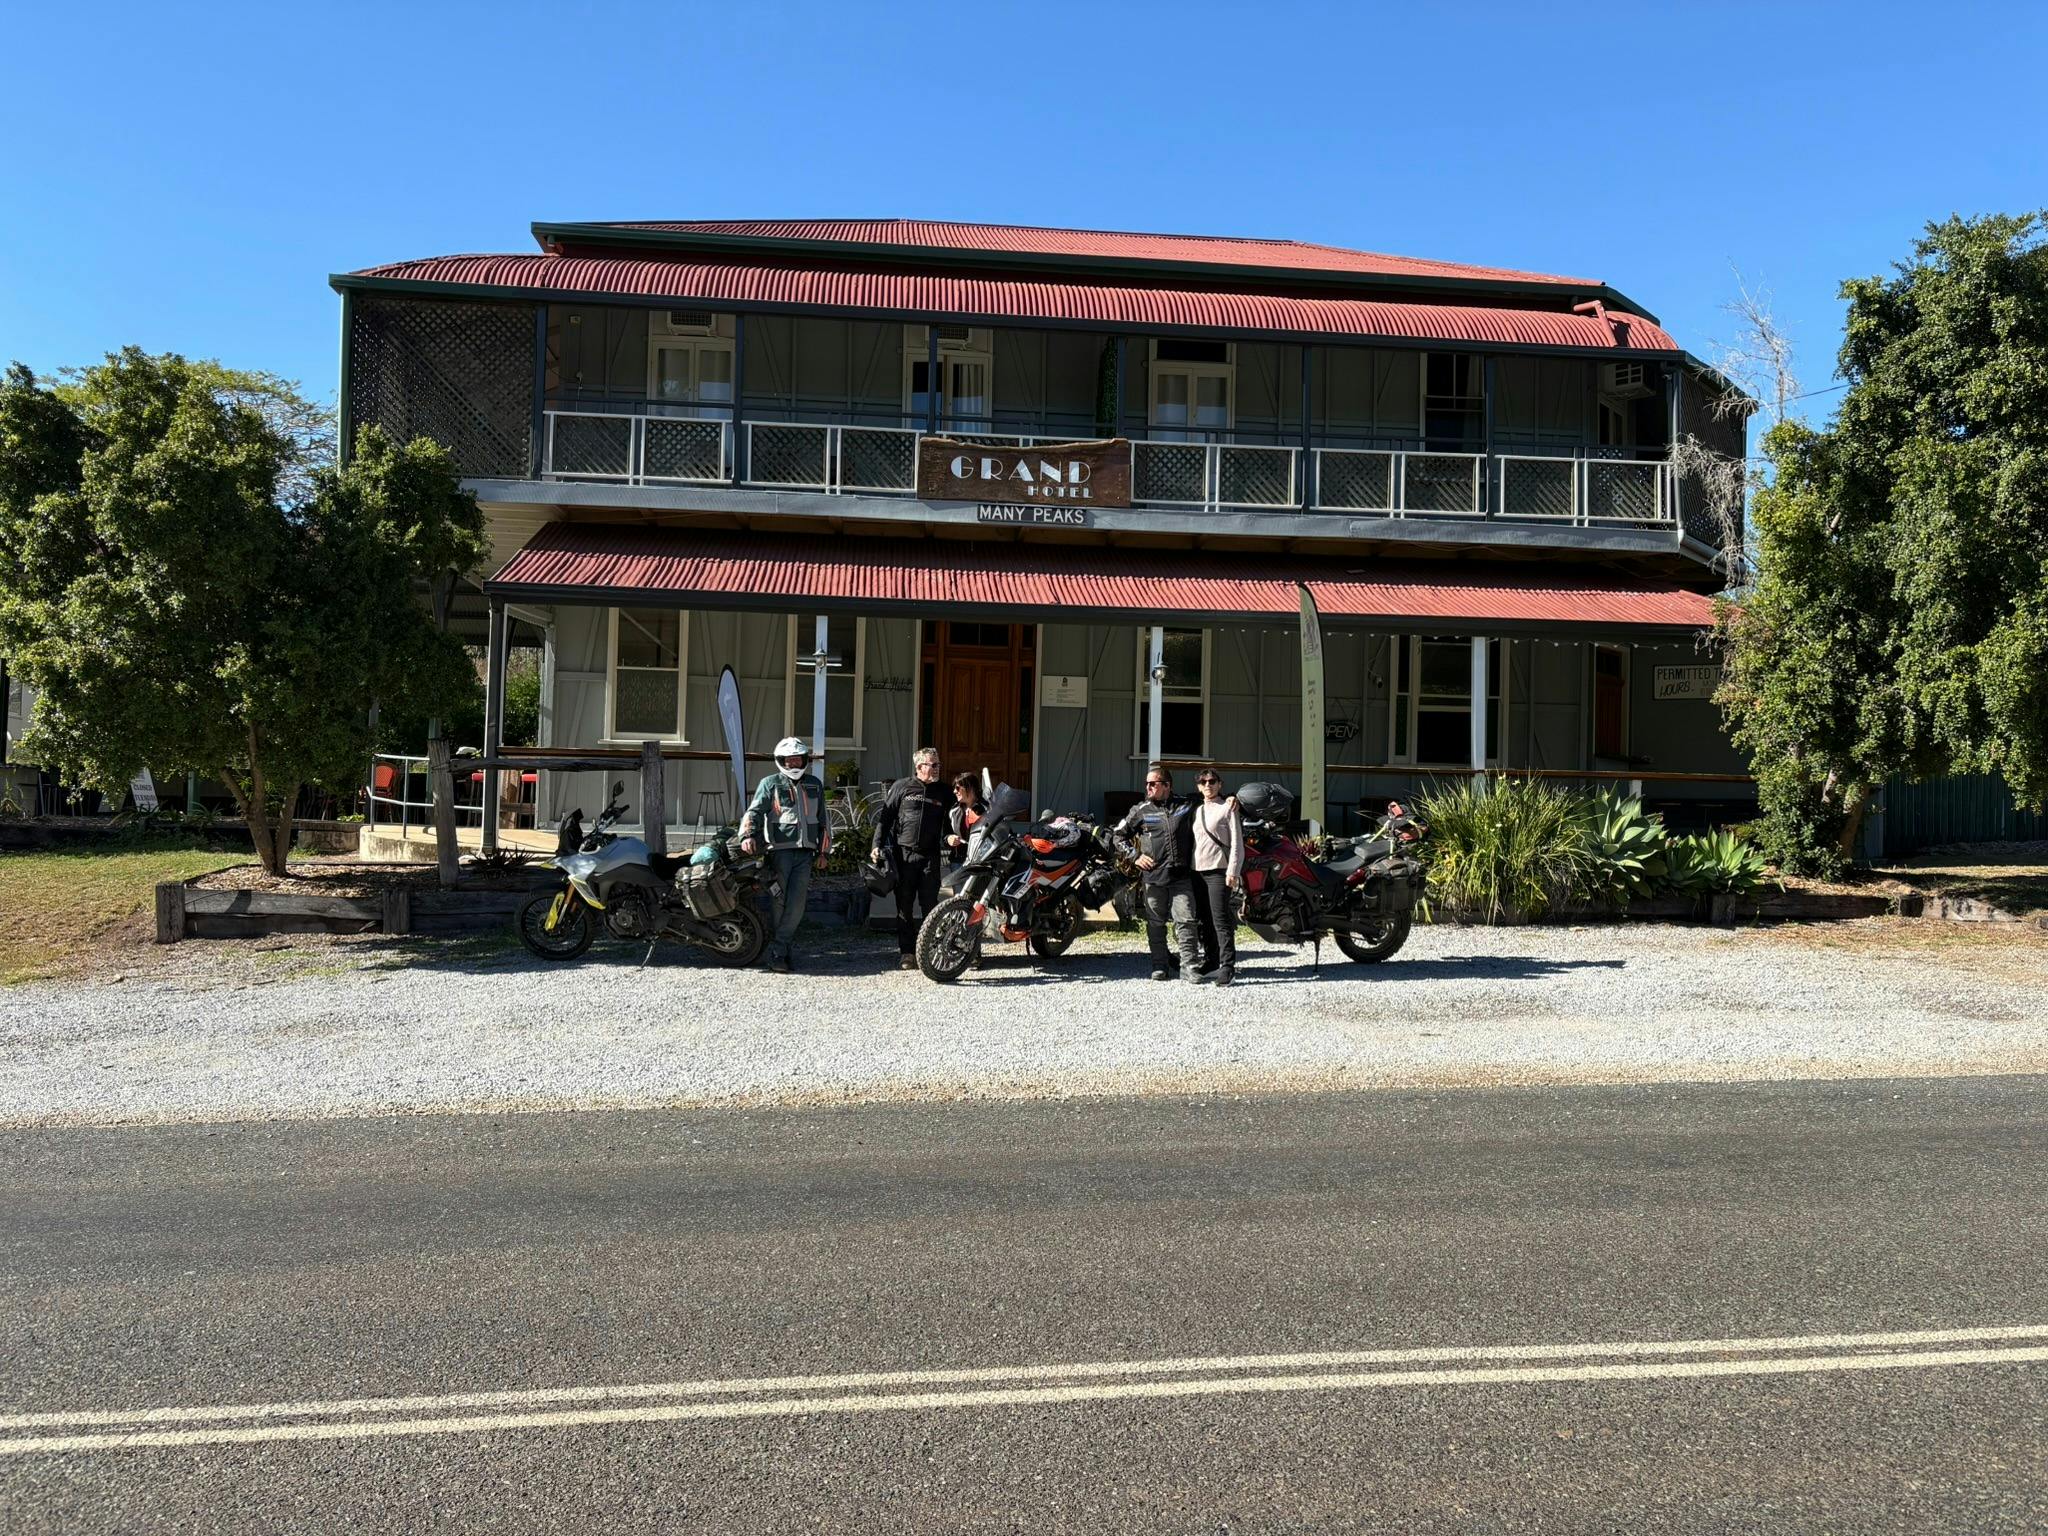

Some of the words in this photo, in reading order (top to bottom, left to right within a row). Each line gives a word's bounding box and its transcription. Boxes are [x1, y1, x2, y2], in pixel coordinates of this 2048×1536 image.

[950, 455, 1091, 484] GRAND
[1027, 485, 1093, 499] HOTEL
[979, 506, 1026, 521] MANY
[1033, 508, 1085, 524] PEAKS
[1657, 667, 1711, 680] PERMITTED
[1326, 725, 1354, 738] PEN
